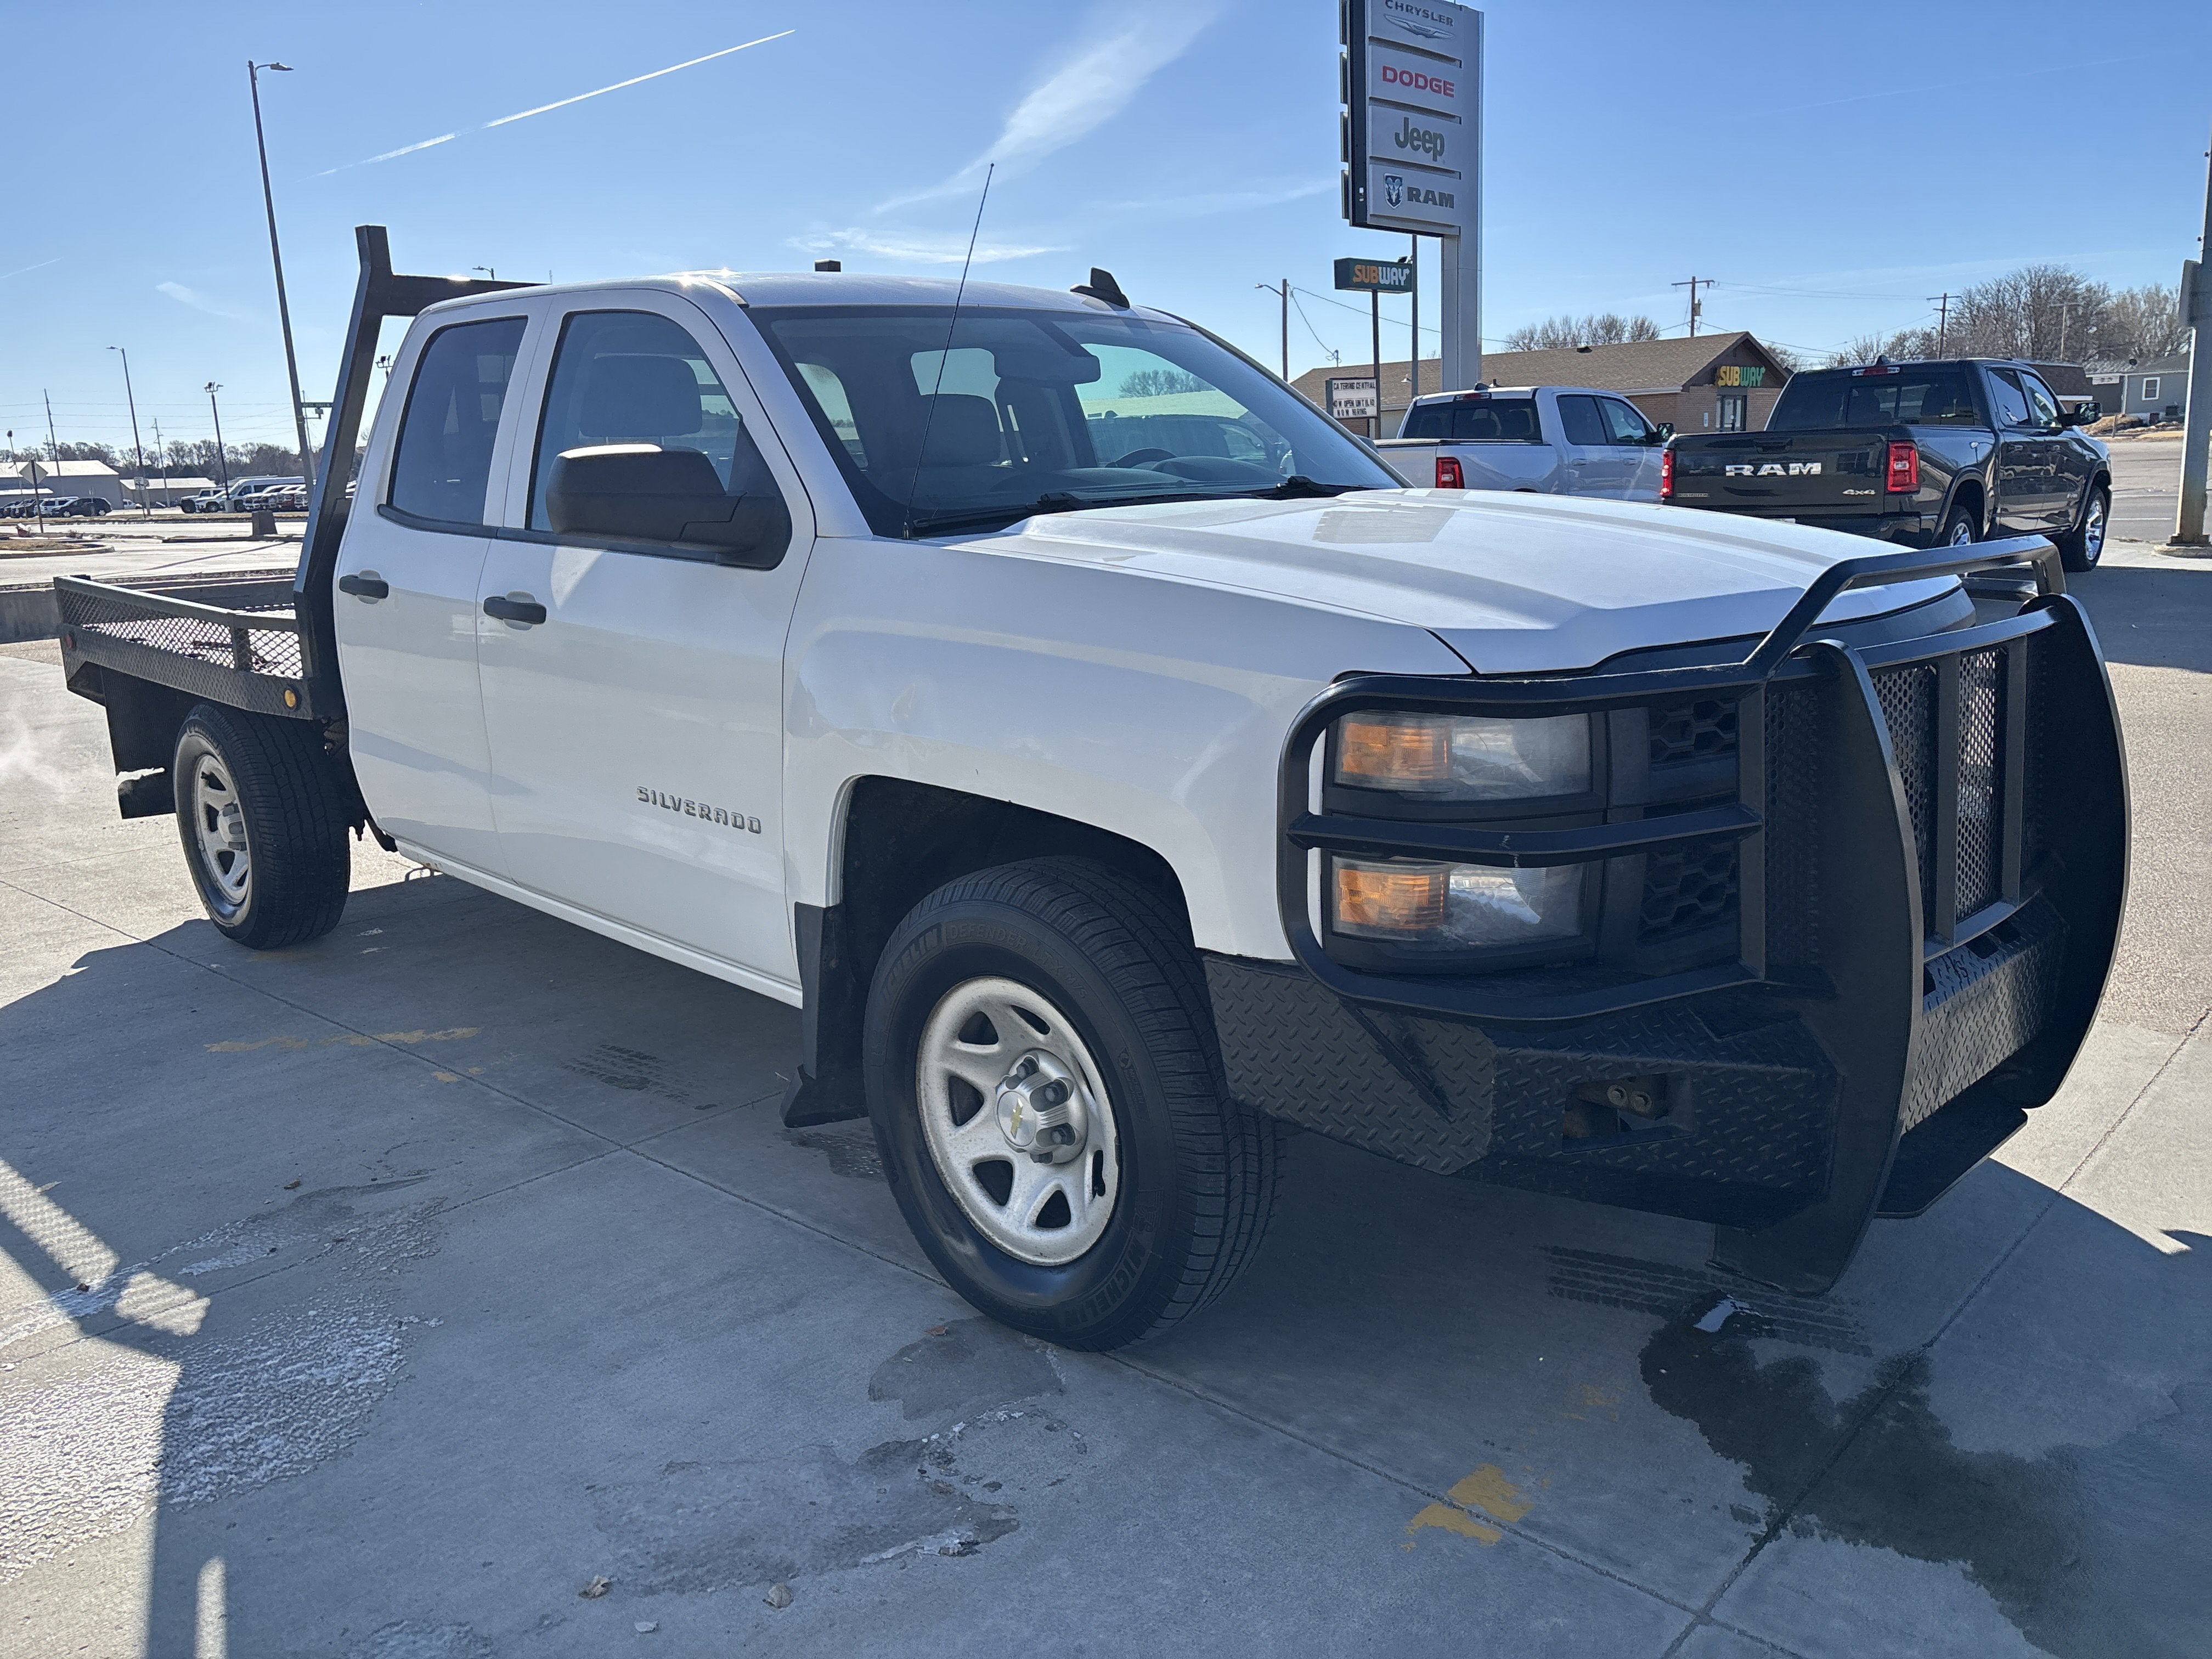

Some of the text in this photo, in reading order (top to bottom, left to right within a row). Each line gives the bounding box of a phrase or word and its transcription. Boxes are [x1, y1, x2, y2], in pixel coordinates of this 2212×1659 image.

[1385, 0, 1454, 27] CHRYSLER
[1383, 65, 1454, 98] DODGE
[1395, 117, 1444, 161] Jeep
[1407, 186, 1454, 209] RAM
[1353, 264, 1410, 286] SUBWAY
[1333, 381, 1375, 390] CATERING CENTRAL
[1717, 365, 1765, 387] SUBWAY
[1725, 462, 1822, 477] RAM
[636, 786, 761, 834] SILVERADO
[951, 924, 1029, 949] DEFENDER
